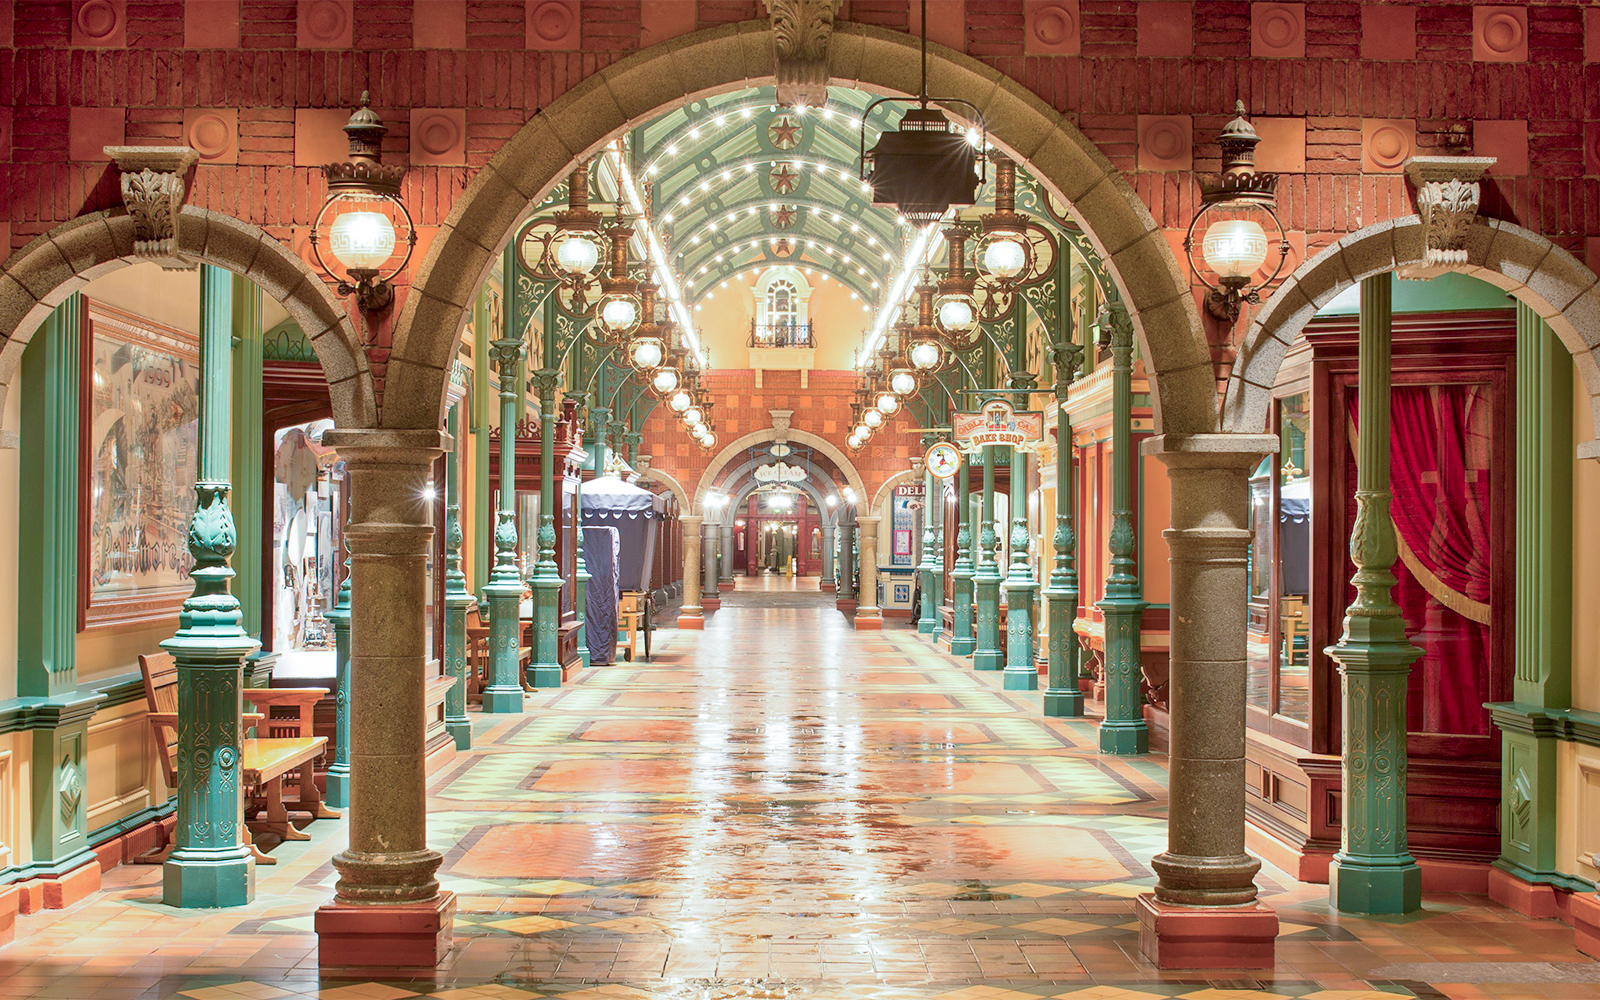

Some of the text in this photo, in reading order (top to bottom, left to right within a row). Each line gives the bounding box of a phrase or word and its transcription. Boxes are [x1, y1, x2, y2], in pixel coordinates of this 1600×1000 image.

[144, 366, 170, 388] 1999
[958, 420, 984, 435] CABLE
[972, 433, 1024, 446] BAKE SHOP
